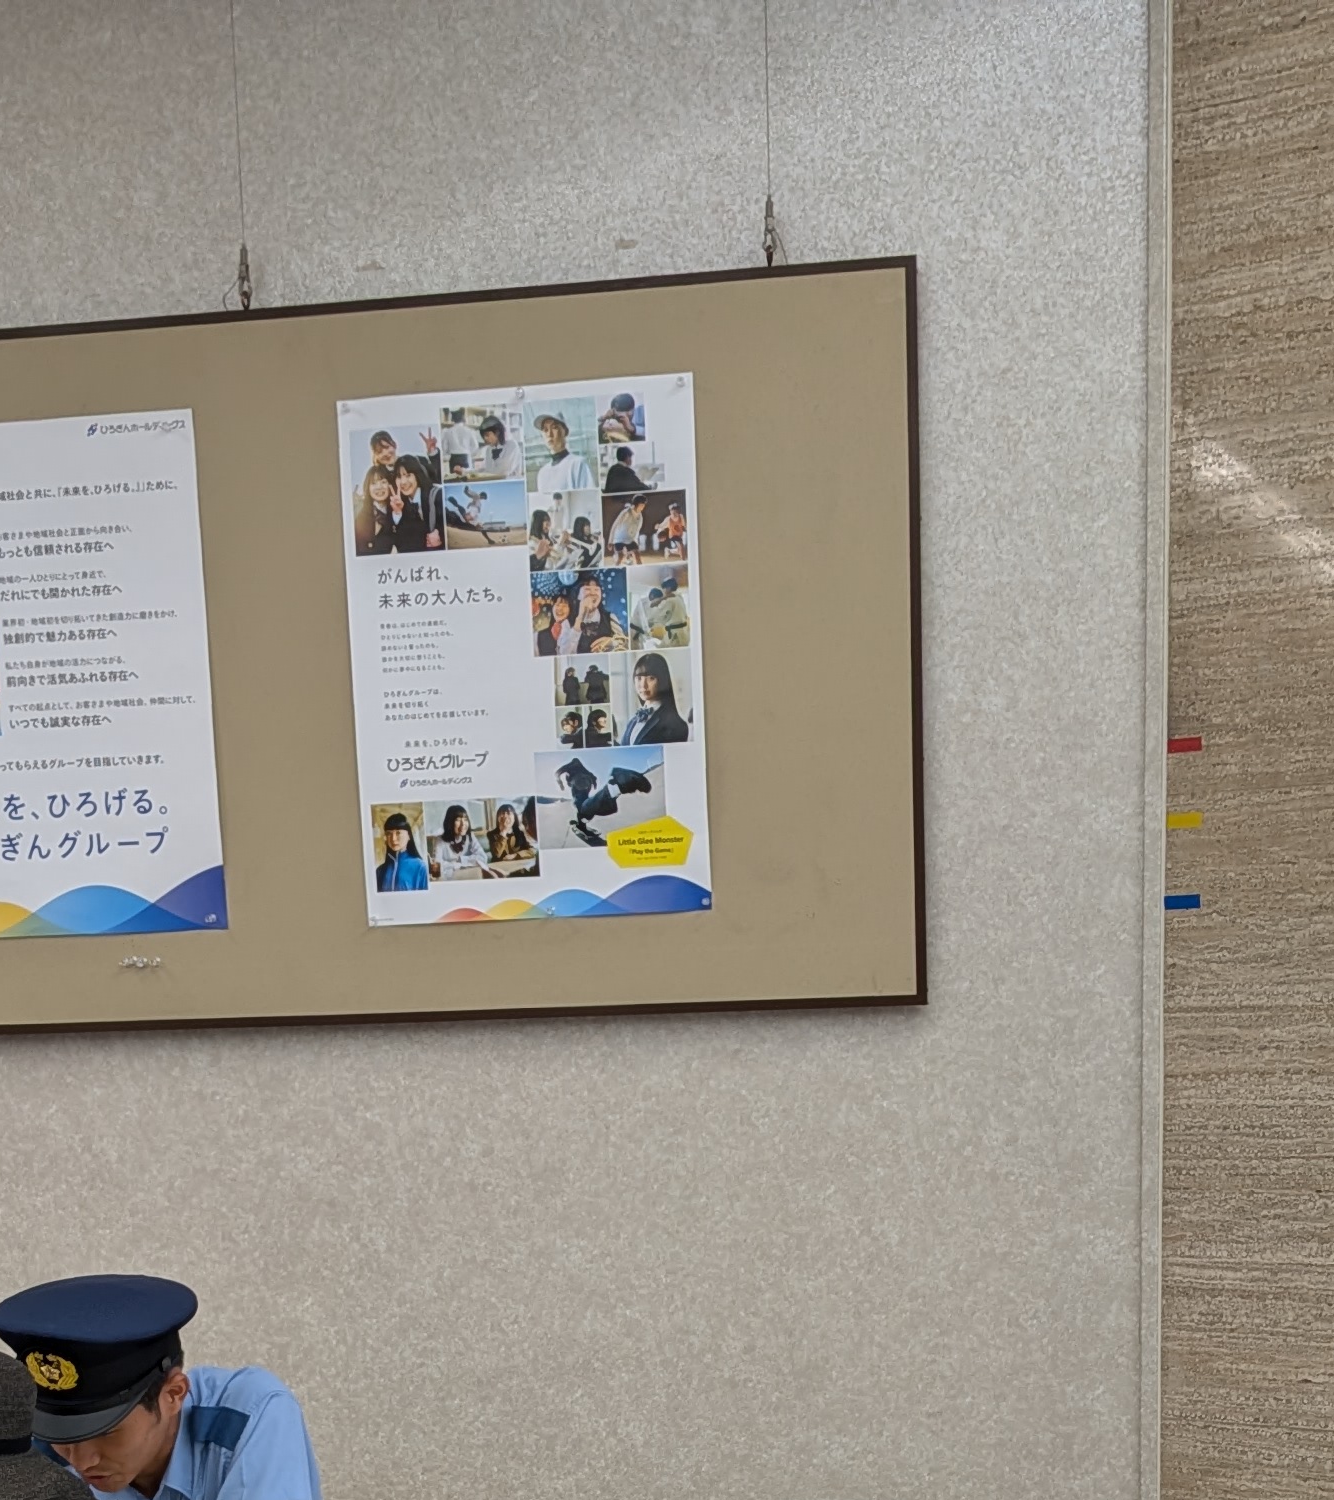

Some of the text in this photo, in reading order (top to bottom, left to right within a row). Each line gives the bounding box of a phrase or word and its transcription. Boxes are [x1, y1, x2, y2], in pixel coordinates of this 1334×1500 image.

[377, 565, 451, 587] がんばれ、
[0, 584, 123, 602] だれにでも開かれた存在へ
[378, 585, 505, 610] 未来の大人たち。
[6, 670, 139, 688] 前向きで活気あふれる存在へ
[9, 714, 112, 730] いつでも誠実な存在へ
[386, 750, 490, 773] ひろぎんグループ
